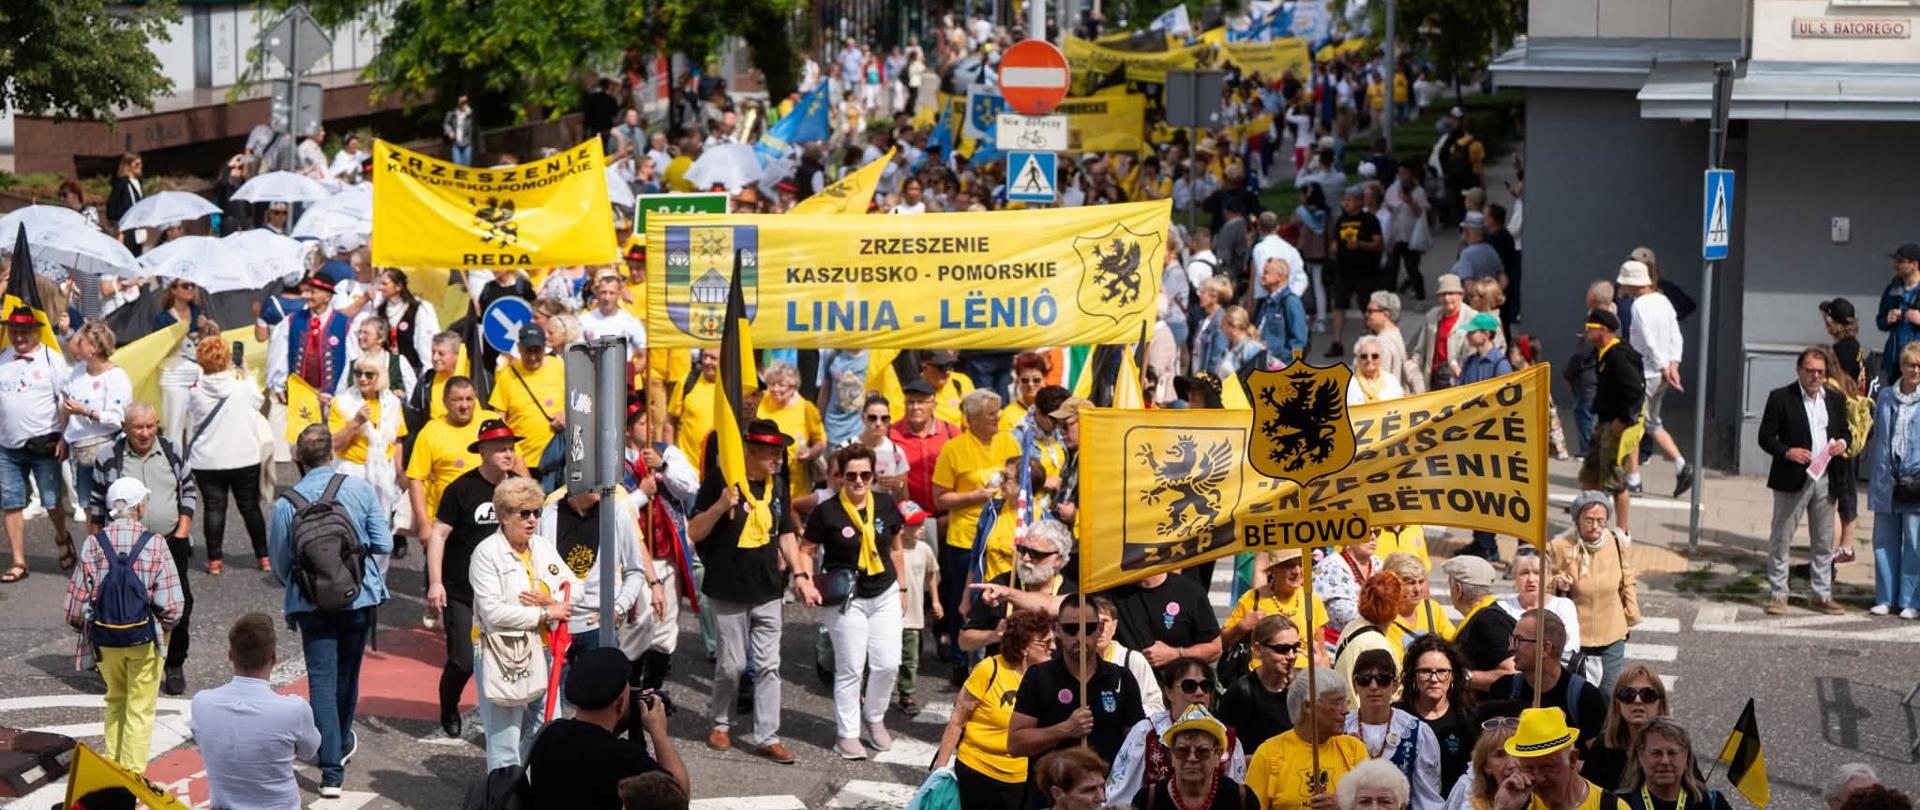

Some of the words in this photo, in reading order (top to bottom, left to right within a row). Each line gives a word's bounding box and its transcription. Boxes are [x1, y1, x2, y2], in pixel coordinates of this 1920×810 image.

[1834, 22, 1904, 35] BATOREGO
[1003, 117, 1019, 126] Nie
[1025, 117, 1061, 129] dotyczy
[388, 149, 590, 183] ZRZESZENIE
[859, 236, 990, 256] ZRZESZENIE
[463, 253, 532, 265] REDA
[786, 265, 918, 284] KASZUBSKO
[937, 261, 1057, 282] POMORSKIE
[786, 299, 900, 332] LINIA
[939, 287, 1058, 330] LËNIÔ
[1244, 513, 1367, 547] BËTOWÒ
